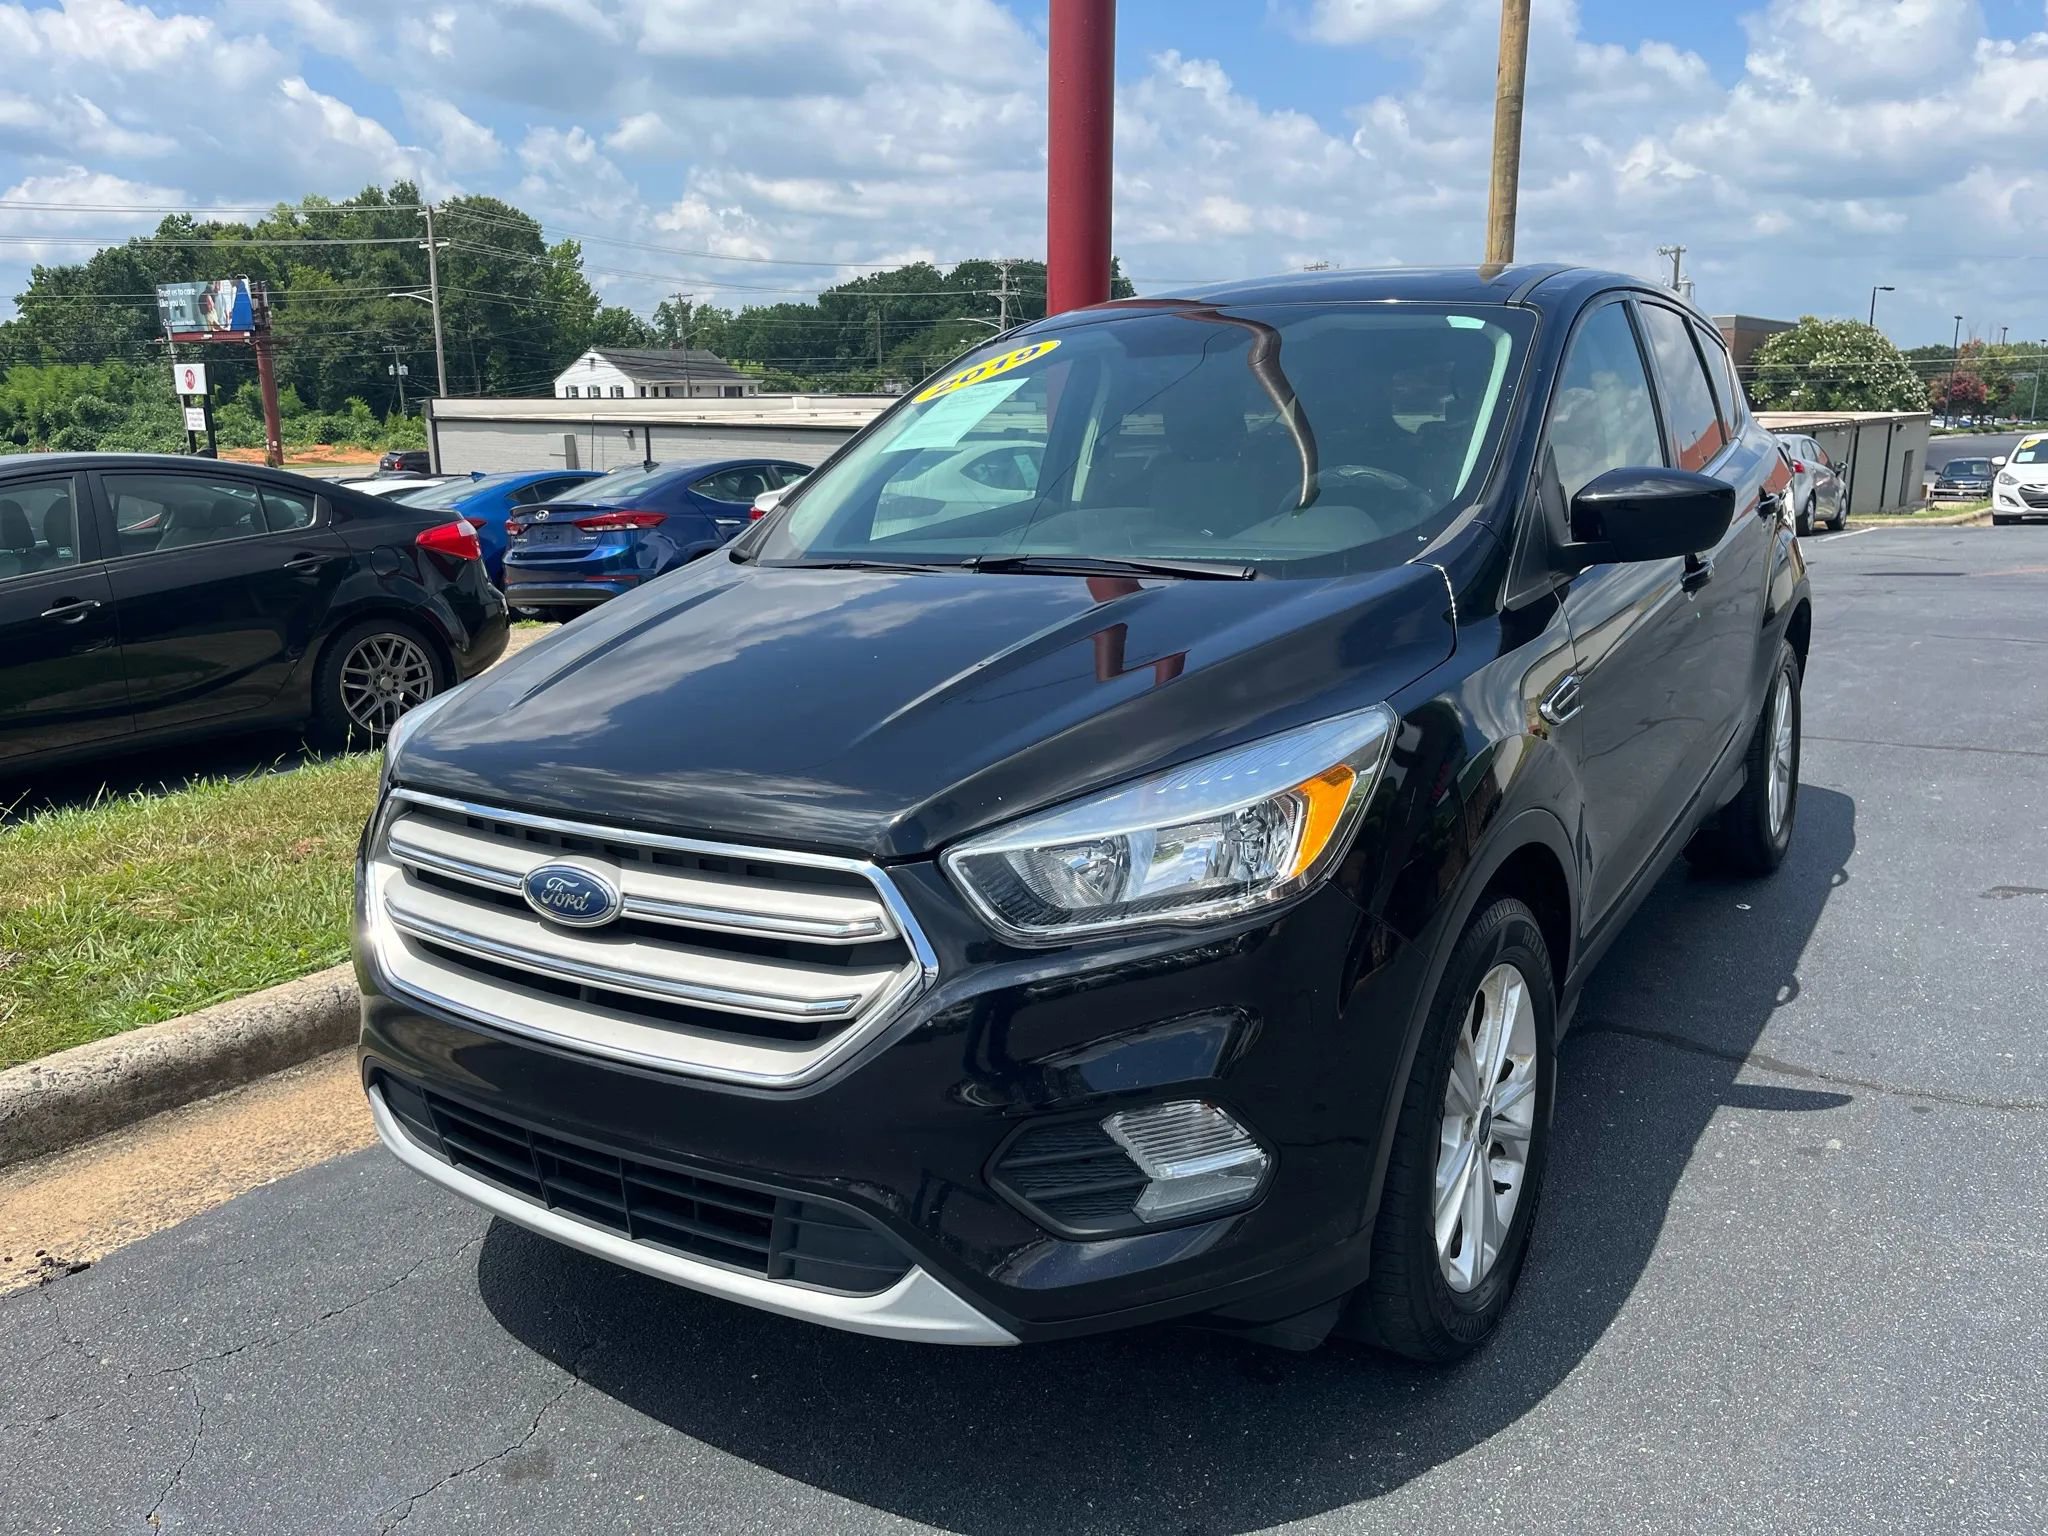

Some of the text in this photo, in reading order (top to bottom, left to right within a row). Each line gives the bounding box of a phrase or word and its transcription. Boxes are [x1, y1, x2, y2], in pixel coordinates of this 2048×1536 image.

[158, 289, 171, 297] Trust
[169, 299, 179, 310] you
[929, 346, 1042, 398] 2019
[540, 877, 592, 912] Ford
